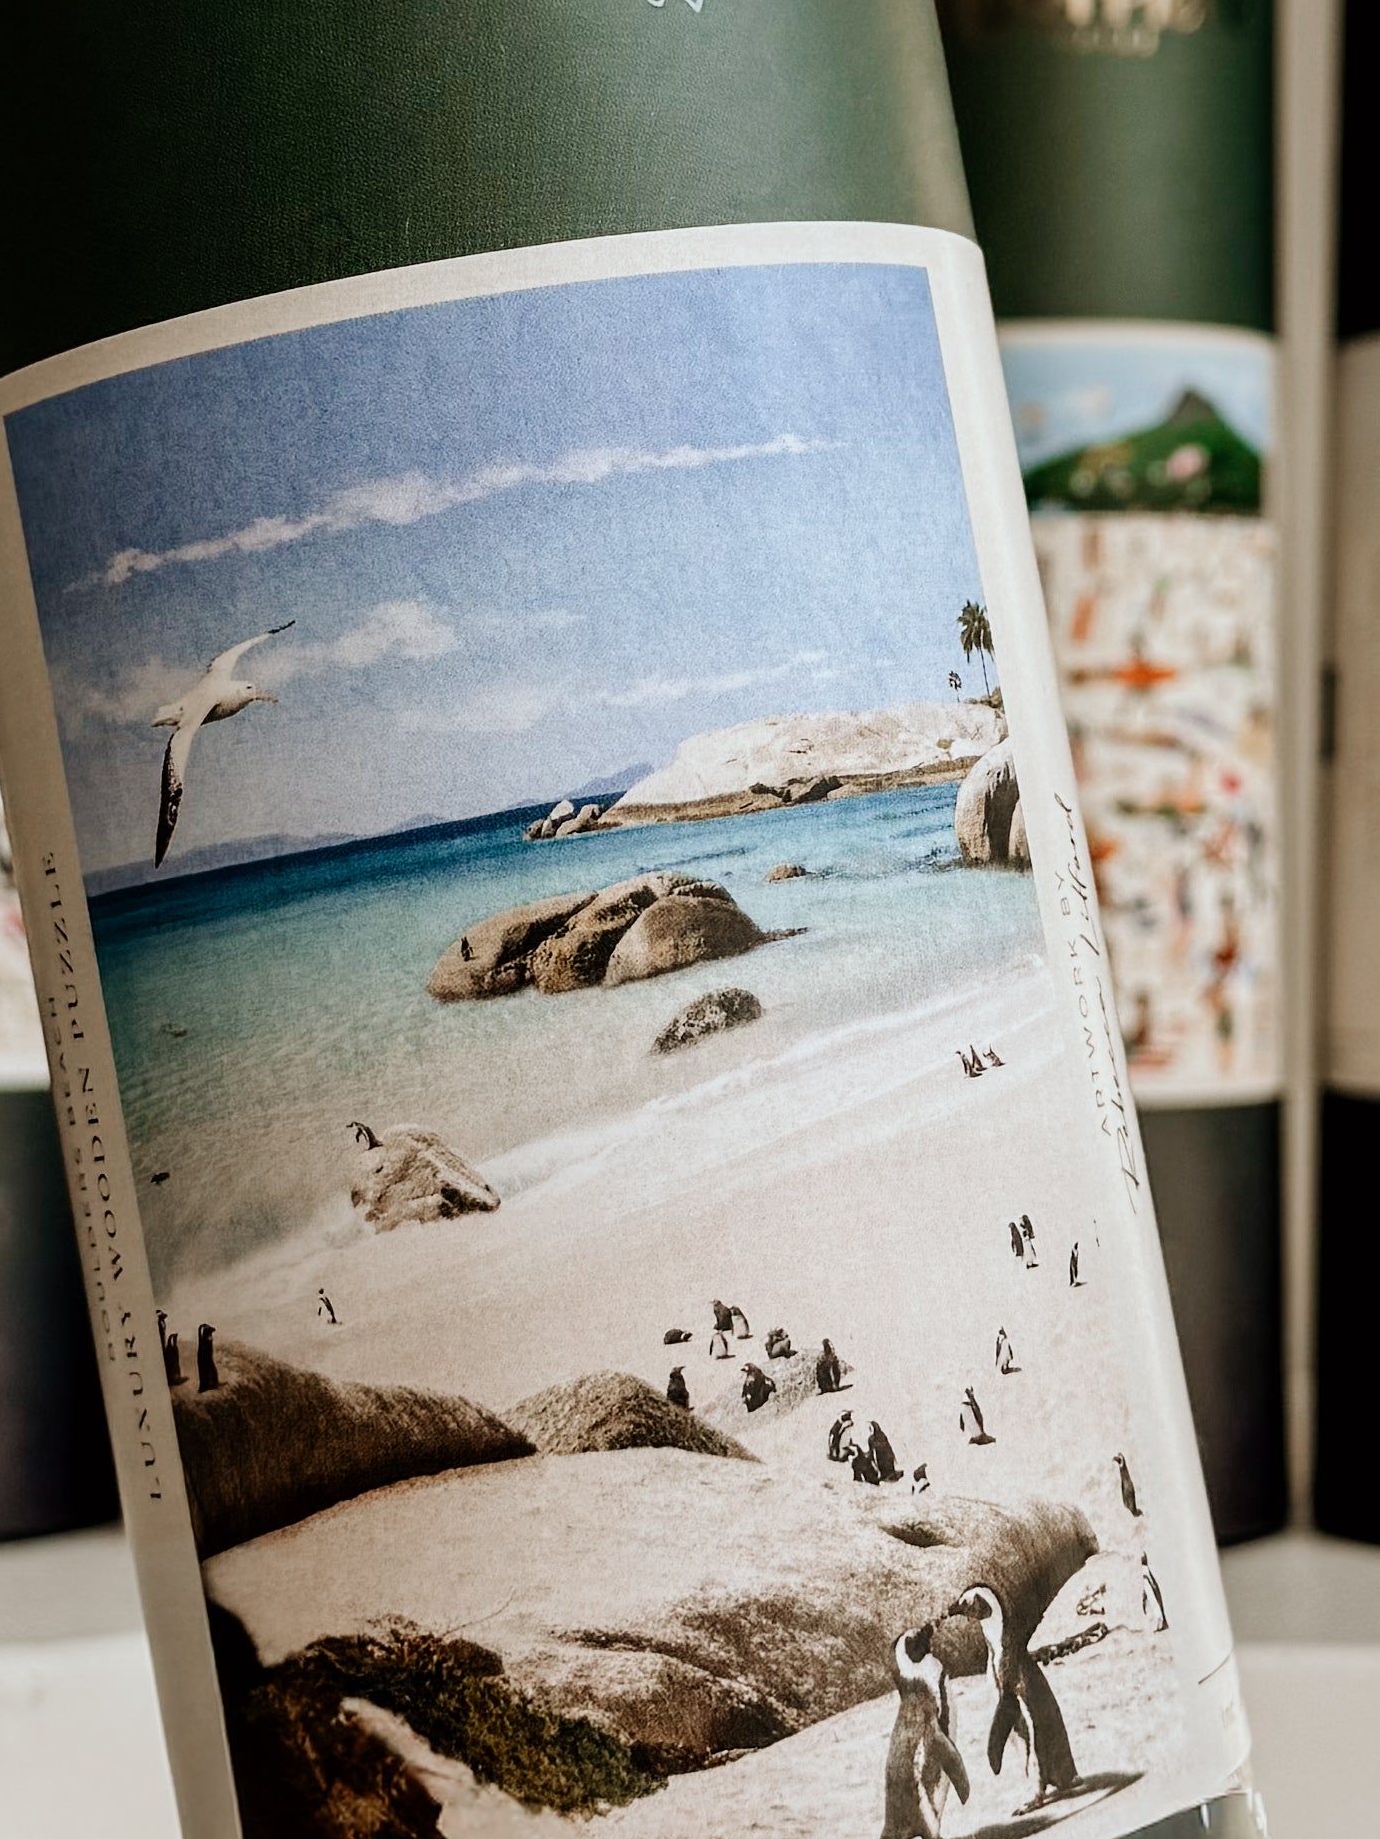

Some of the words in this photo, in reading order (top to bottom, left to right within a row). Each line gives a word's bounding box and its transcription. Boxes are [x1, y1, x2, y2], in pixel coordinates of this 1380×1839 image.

[41, 851, 86, 1040] PUZZLE
[1054, 870, 1073, 917] BY
[1067, 938, 1113, 1138] ARTWORK
[77, 1066, 124, 1282] WOODEN
[116, 1304, 164, 1500] LUXURY
